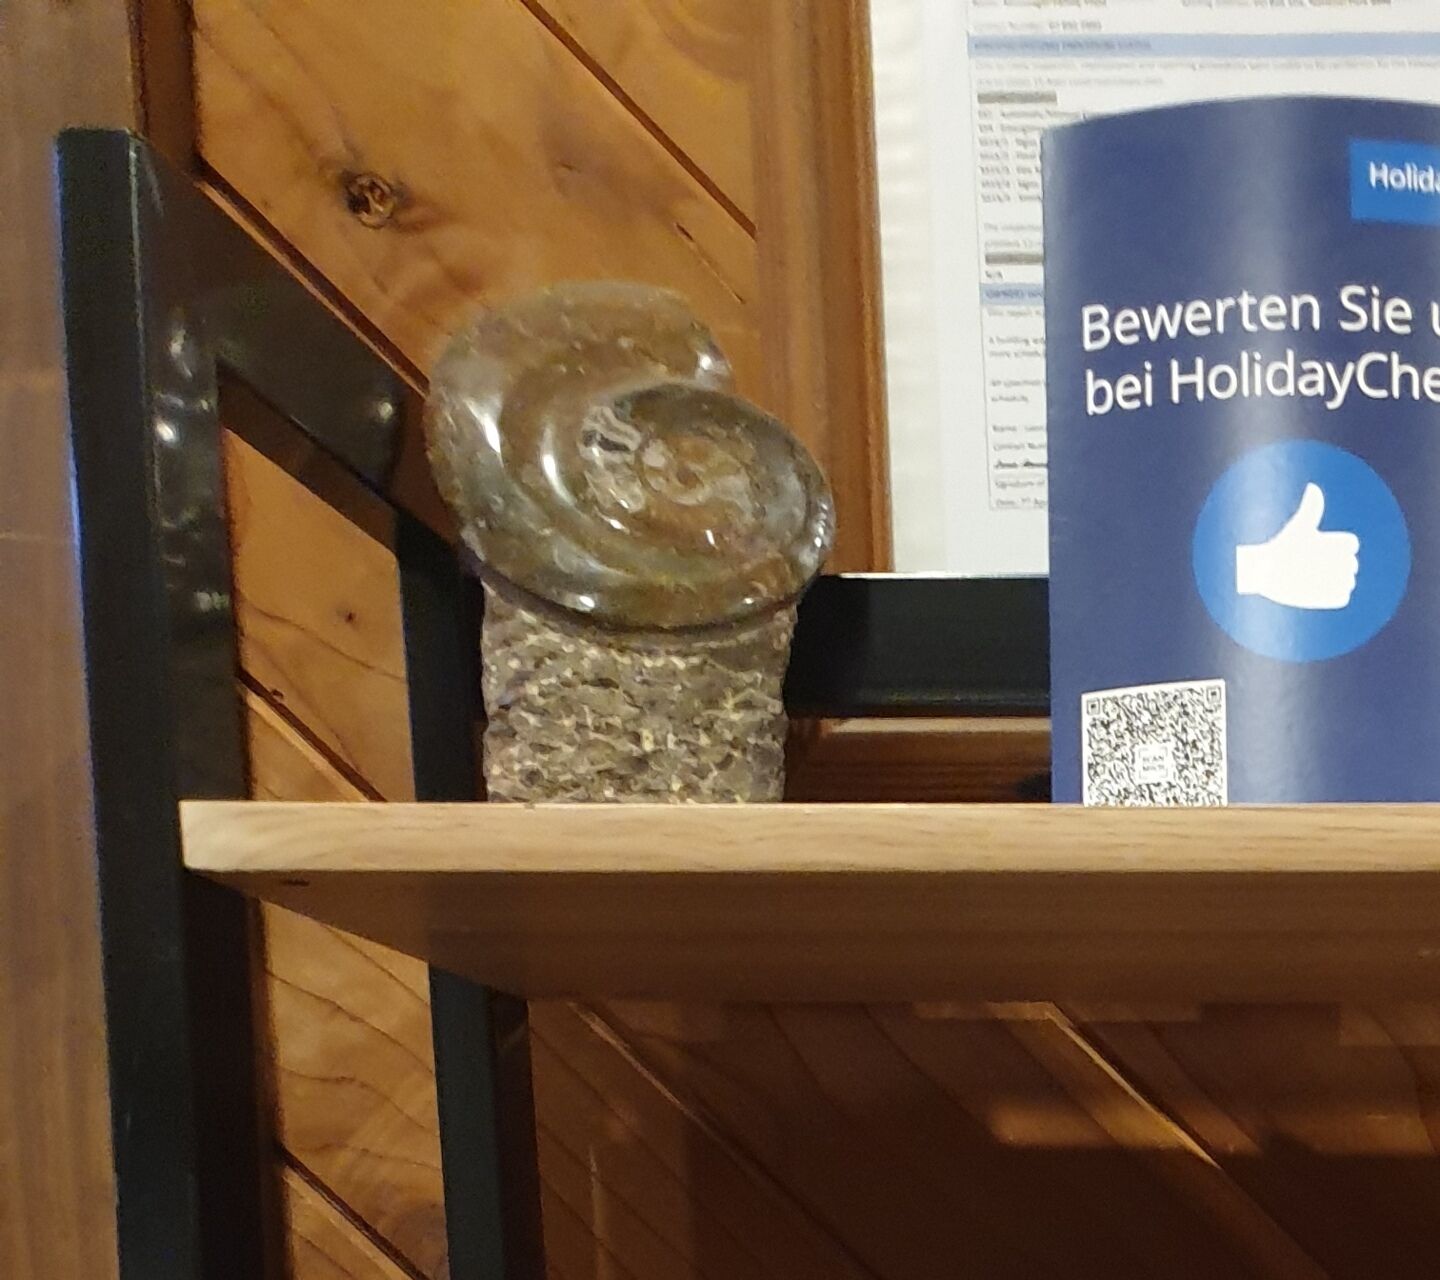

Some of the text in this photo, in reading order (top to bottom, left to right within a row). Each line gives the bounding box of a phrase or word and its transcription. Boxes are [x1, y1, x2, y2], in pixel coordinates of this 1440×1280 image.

[1081, 289, 1321, 351] Bewerten
[1338, 285, 1413, 334] Sie
[1085, 361, 1154, 416] bei
